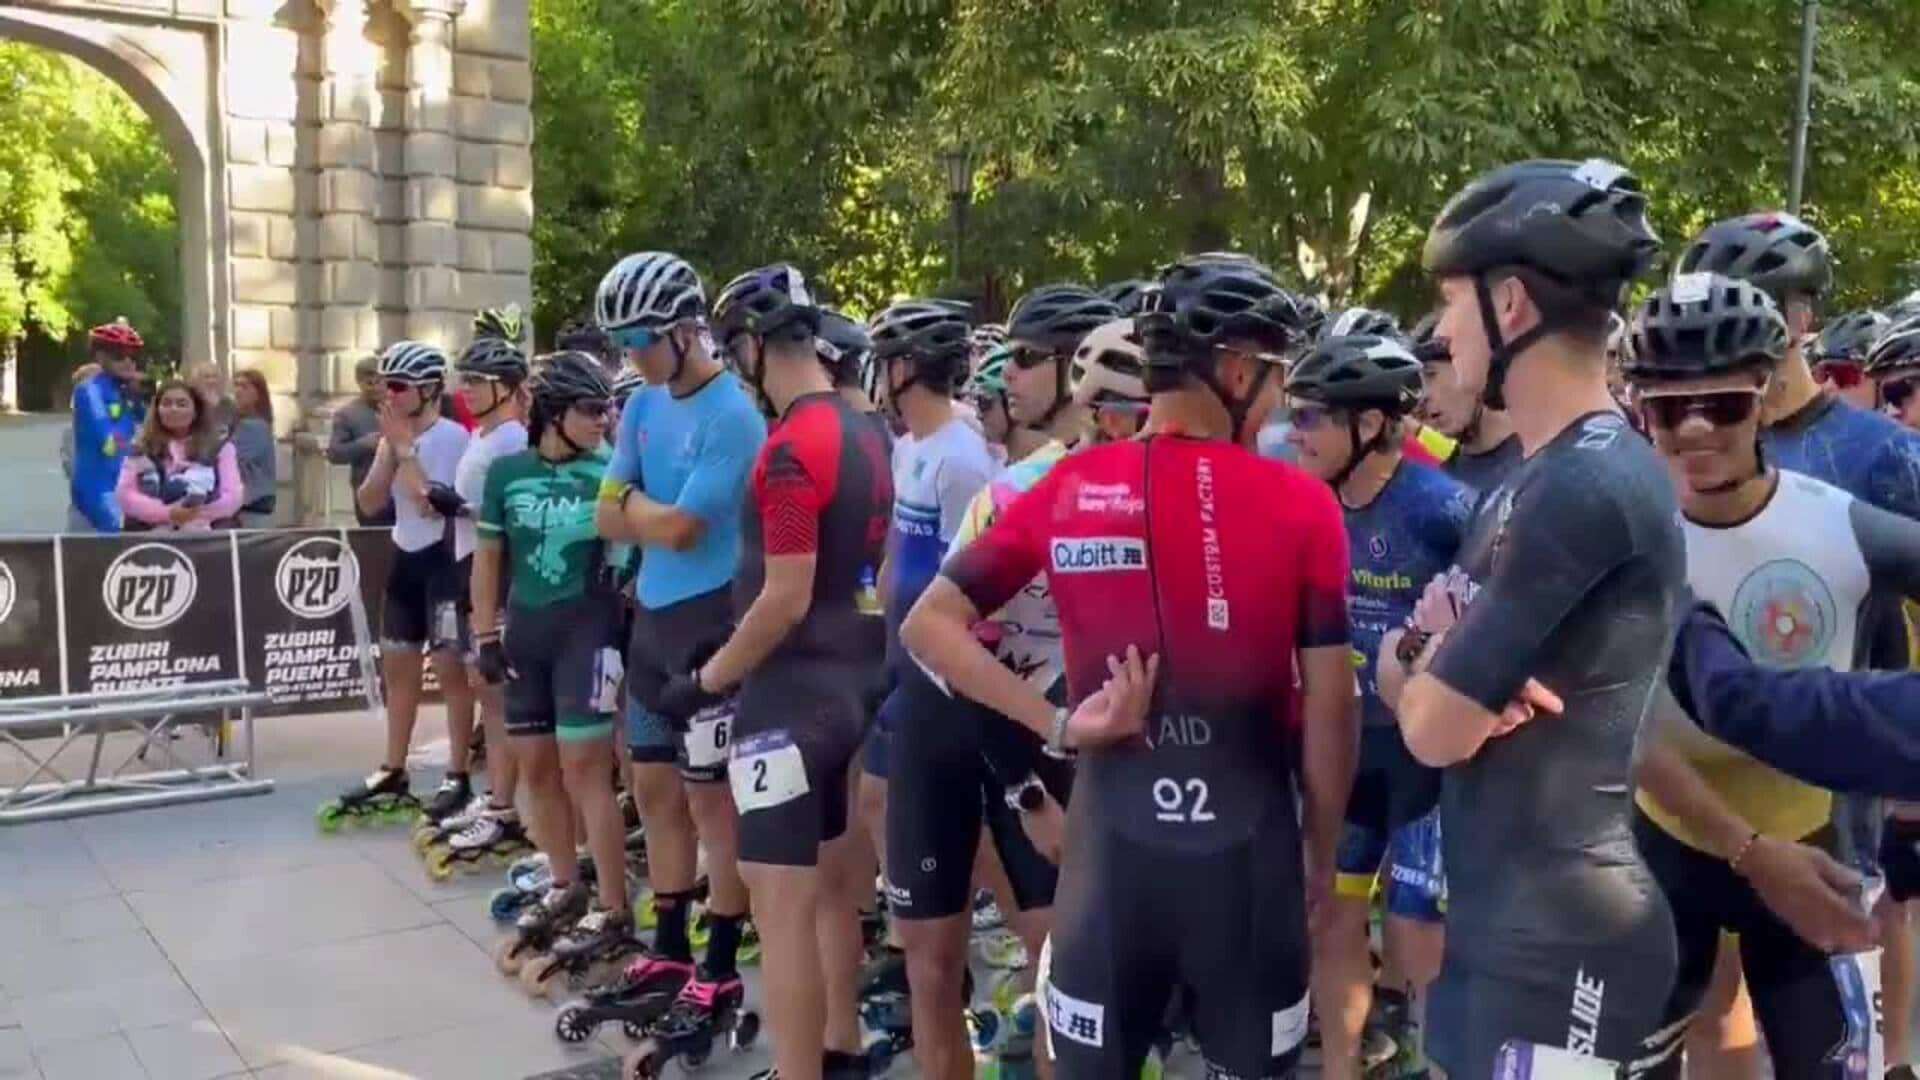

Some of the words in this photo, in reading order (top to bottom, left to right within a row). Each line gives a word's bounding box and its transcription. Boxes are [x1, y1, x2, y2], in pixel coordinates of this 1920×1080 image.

[1054, 543, 1118, 569] Cubitt
[117, 573, 177, 617] P2P
[288, 565, 340, 607] P2P
[89, 640, 170, 663] ZUBIRI
[264, 629, 336, 650] ZUBIRI
[89, 653, 220, 681] PAMPLONA
[265, 662, 350, 685] PUENTE
[714, 722, 728, 749] 6
[1147, 714, 1212, 751] AID
[753, 758, 768, 793] 2
